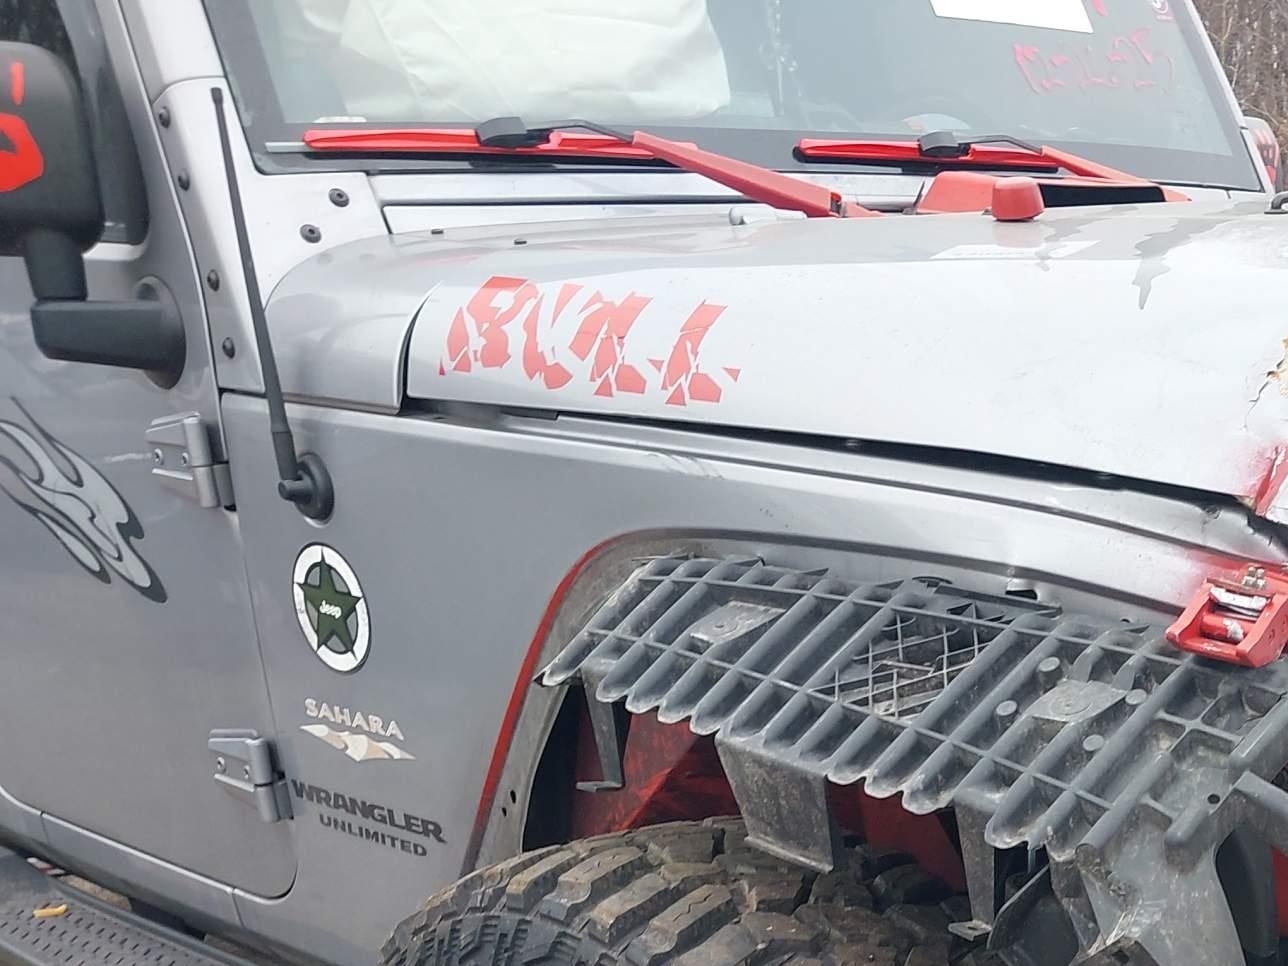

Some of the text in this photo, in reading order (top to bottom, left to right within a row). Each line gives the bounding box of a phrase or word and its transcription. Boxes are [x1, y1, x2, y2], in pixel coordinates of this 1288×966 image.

[444, 275, 732, 406] BULL
[304, 698, 404, 740] SAHARA
[291, 778, 448, 844] WRANGLER
[319, 813, 427, 857] UNLIMITED
